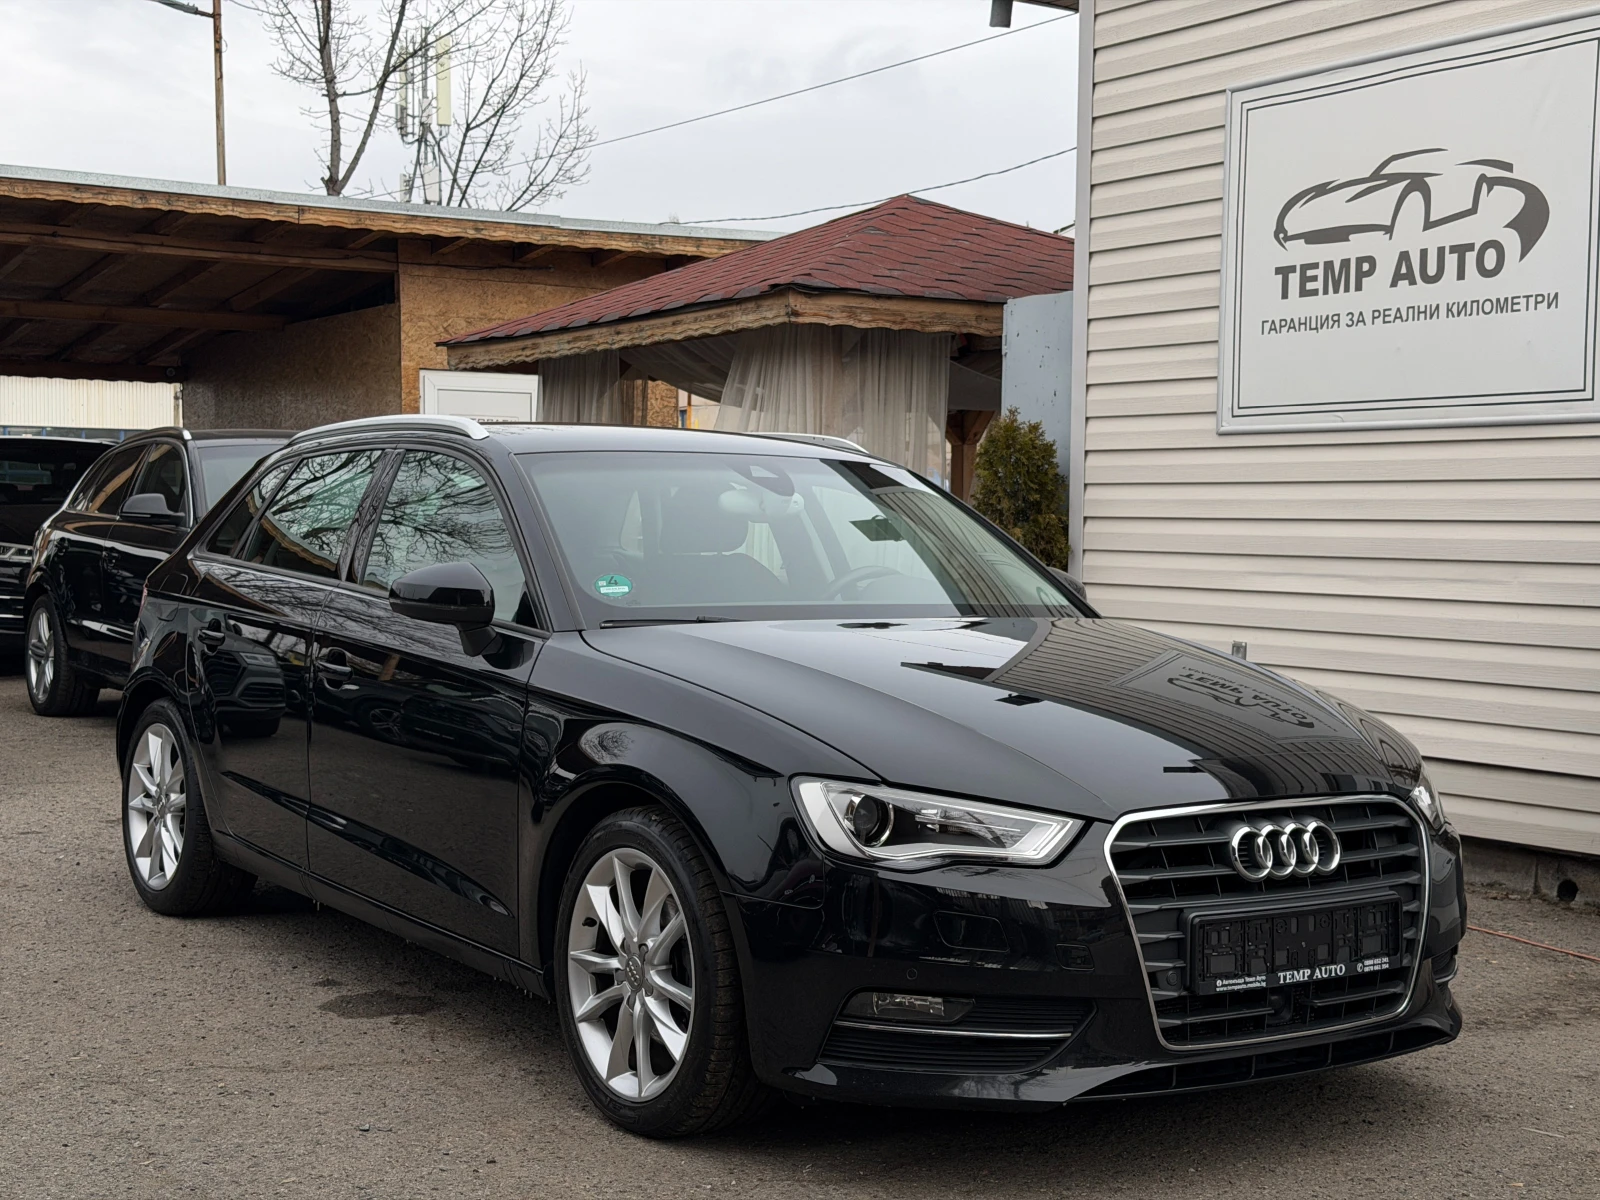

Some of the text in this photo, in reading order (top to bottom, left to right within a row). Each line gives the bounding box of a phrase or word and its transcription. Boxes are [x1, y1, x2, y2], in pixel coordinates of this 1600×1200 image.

[1274, 239, 1506, 300] TEMP AUTO
[1261, 291, 1560, 336] ГАРАНЦИЯ ЗА РЕАЛНИ КИЛОМЕТРИ
[608, 576, 618, 585] 4
[1278, 964, 1345, 984] TEMP AUTO
